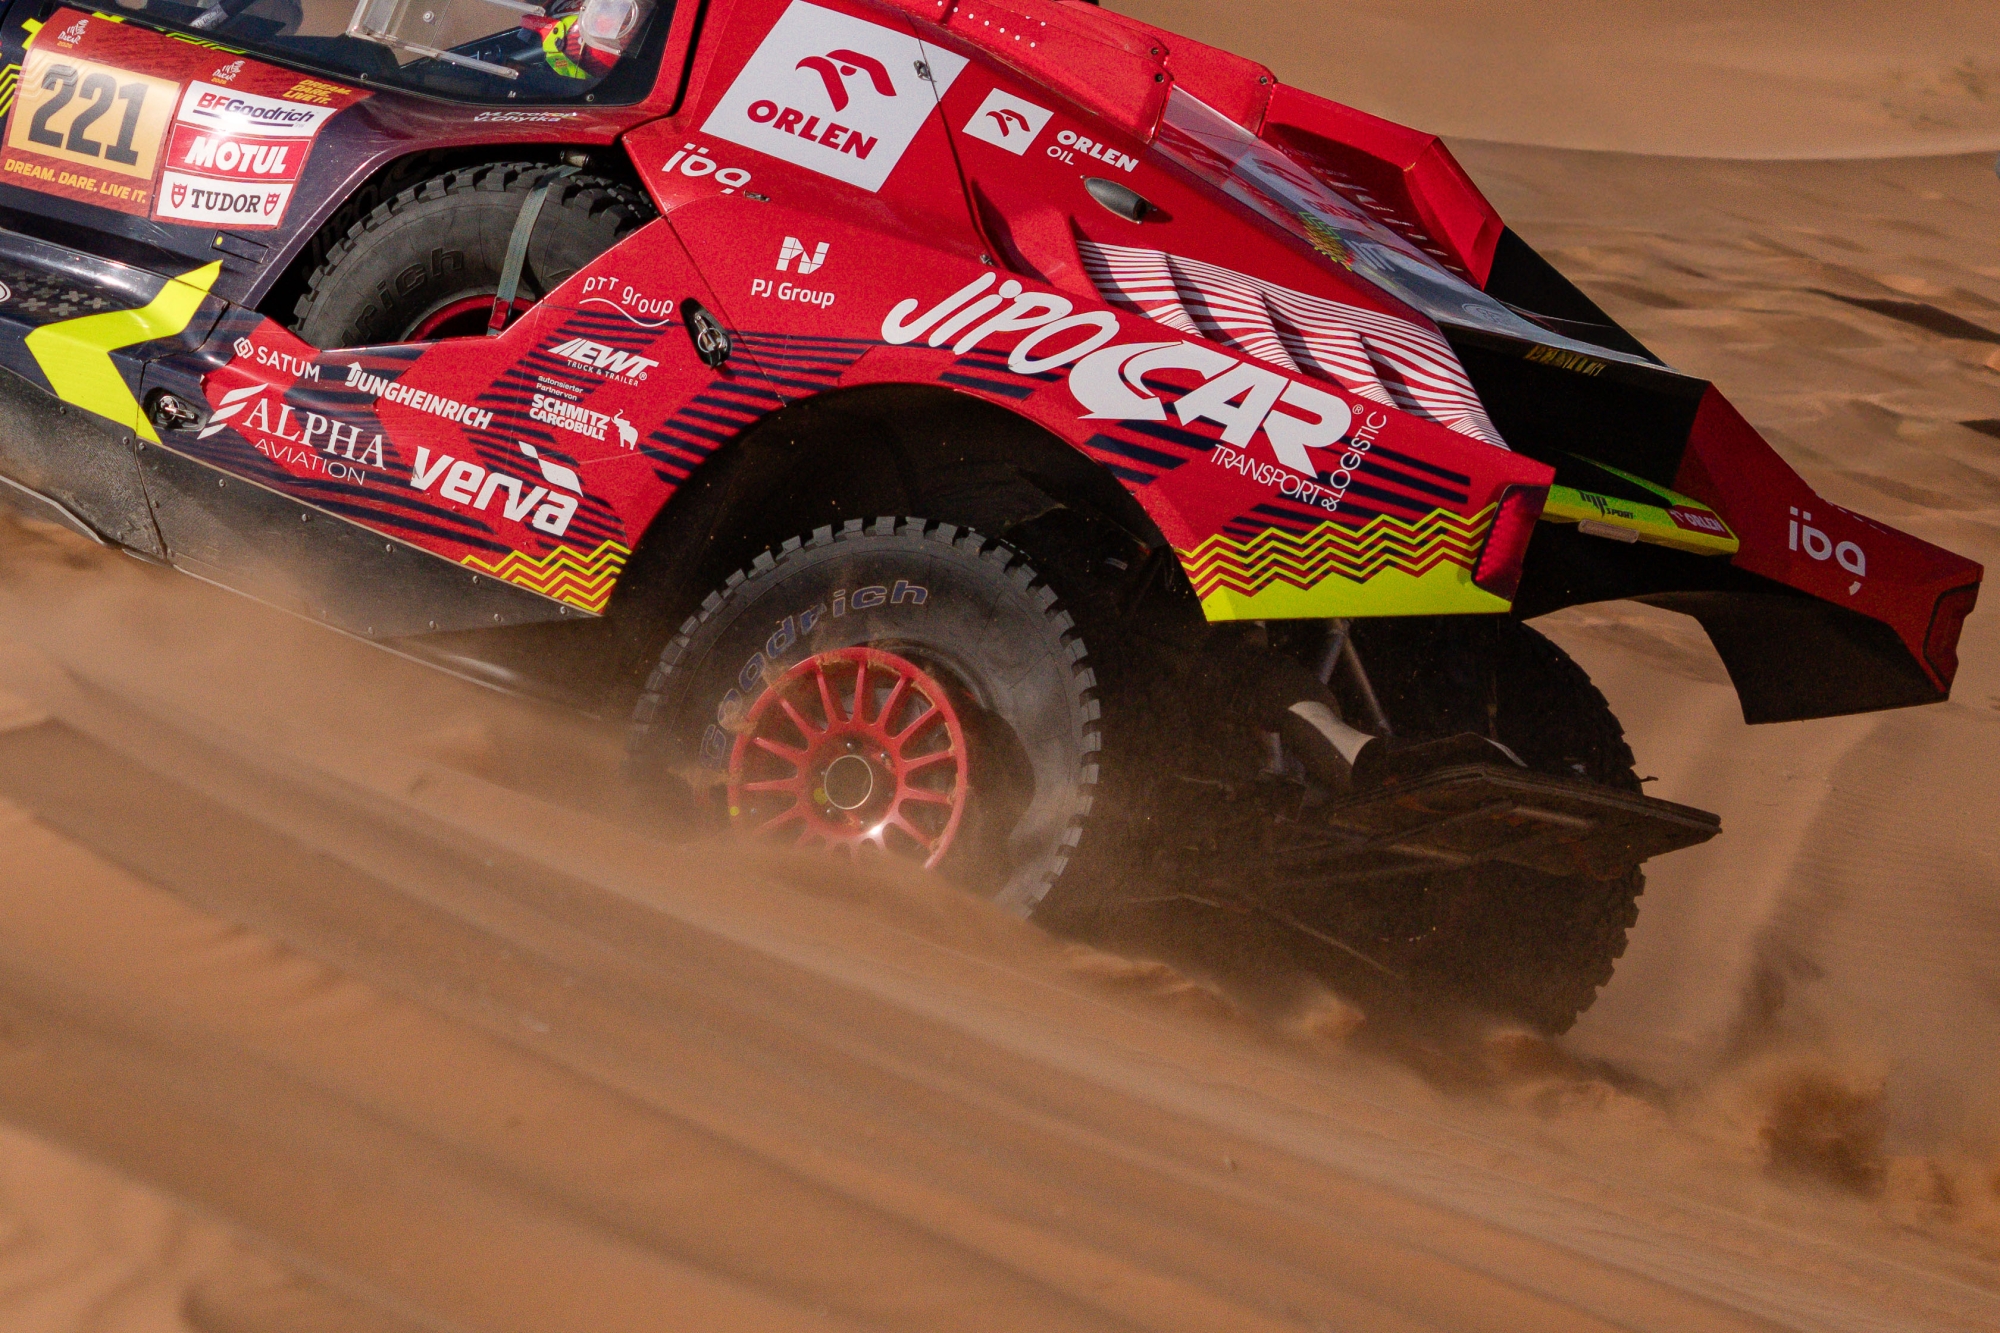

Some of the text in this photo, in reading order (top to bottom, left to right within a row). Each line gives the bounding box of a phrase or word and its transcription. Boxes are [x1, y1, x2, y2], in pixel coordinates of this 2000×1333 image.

[28, 63, 149, 166] 221
[197, 92, 315, 123] BFGoodrich
[747, 99, 878, 160] ORLEN
[184, 136, 289, 174] MOTUL
[1046, 145, 1074, 166] OIL
[1057, 130, 1139, 173] ORLEN
[4, 158, 147, 204] DREAM. DARE. LIVE IT.
[191, 188, 261, 214] TUDOR
[621, 286, 674, 317] group
[751, 278, 835, 309] PJ Group
[256, 346, 320, 383] SATUM
[567, 338, 660, 378] EWT
[567, 359, 639, 388] TRUCK & TRAILER
[345, 363, 493, 430] JUNGHEINRICH
[536, 383, 578, 402] Partner von
[529, 407, 606, 442] CARGOBULL
[531, 393, 612, 431] SCHMITZ
[242, 398, 387, 471] ALPHA
[255, 438, 366, 486] AVIATION
[1211, 444, 1324, 505] TRANSPORT
[410, 445, 578, 537] verva
[1606, 508, 1634, 520] SPORT
[1684, 513, 1726, 533] ORLEN
